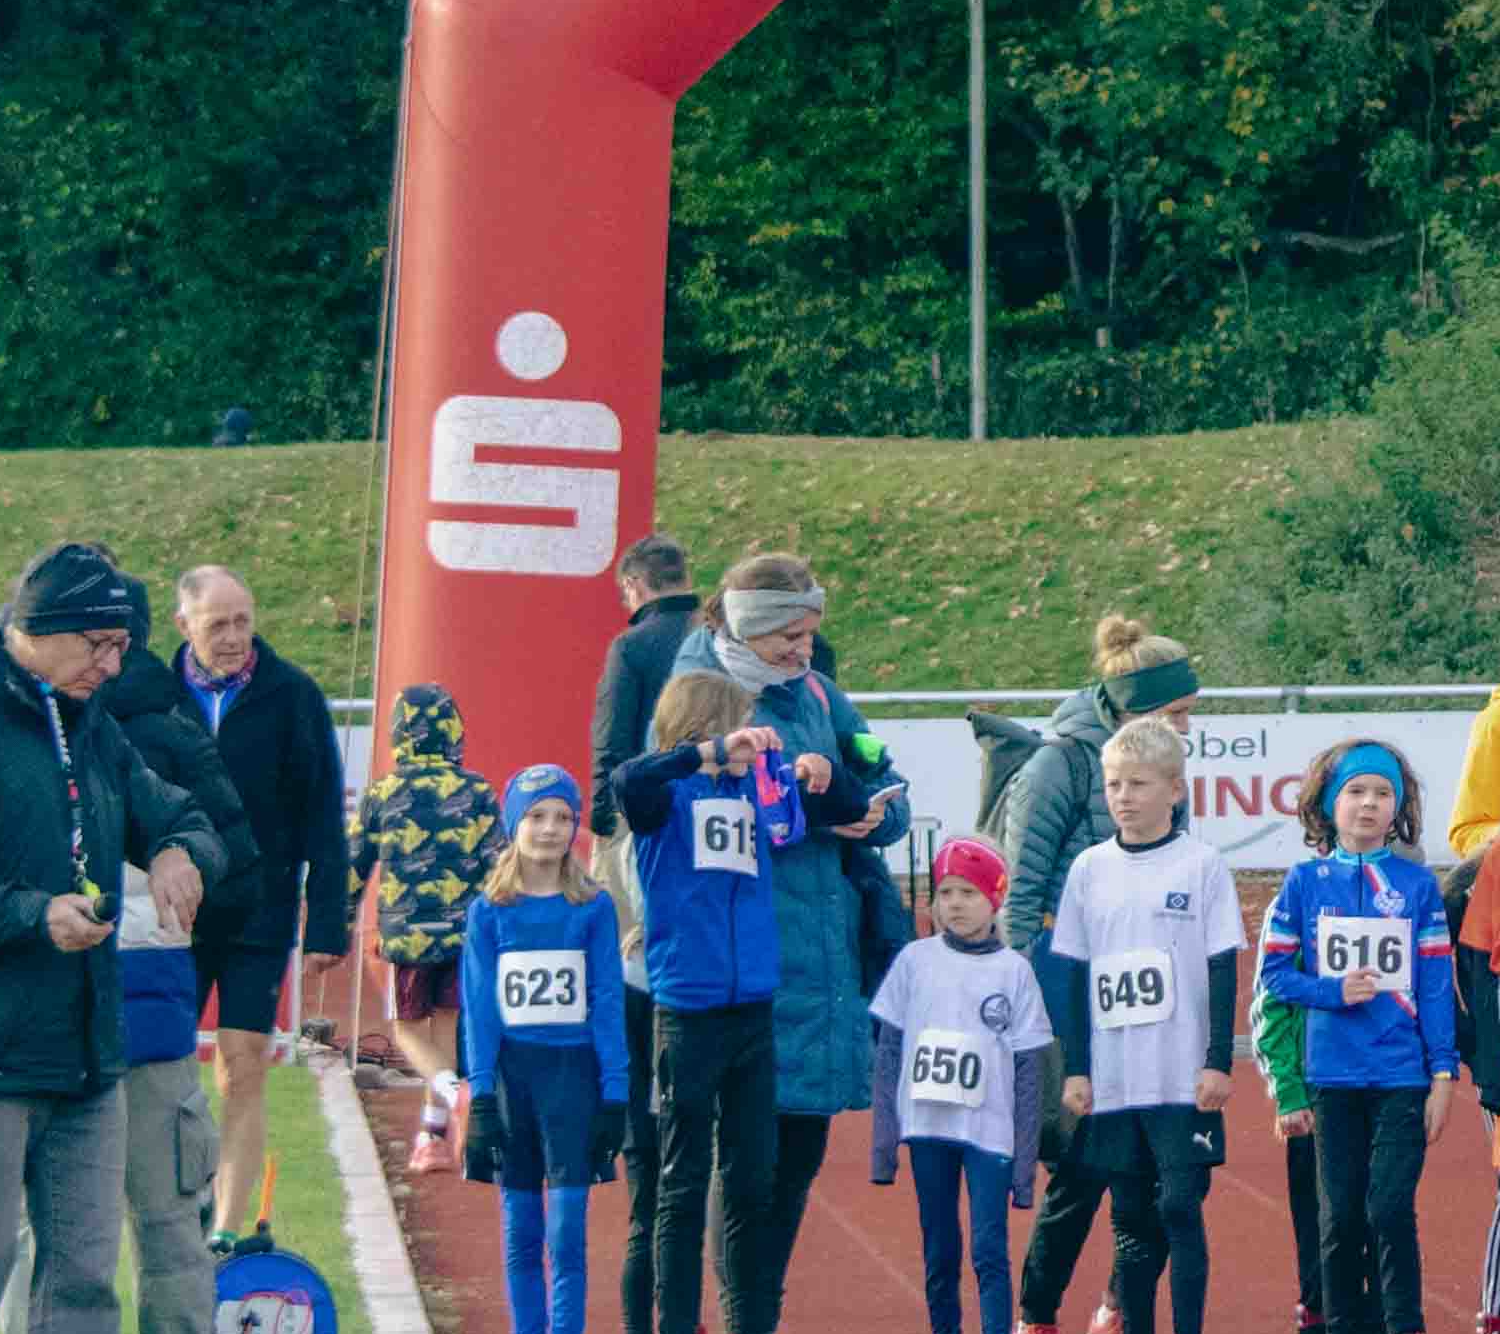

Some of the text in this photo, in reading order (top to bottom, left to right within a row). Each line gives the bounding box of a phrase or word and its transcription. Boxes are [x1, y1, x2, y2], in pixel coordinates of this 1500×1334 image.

[1326, 933, 1403, 974] 616
[504, 968, 576, 1008] 623
[1098, 966, 1164, 1013] 649
[912, 1045, 983, 1090] 650
